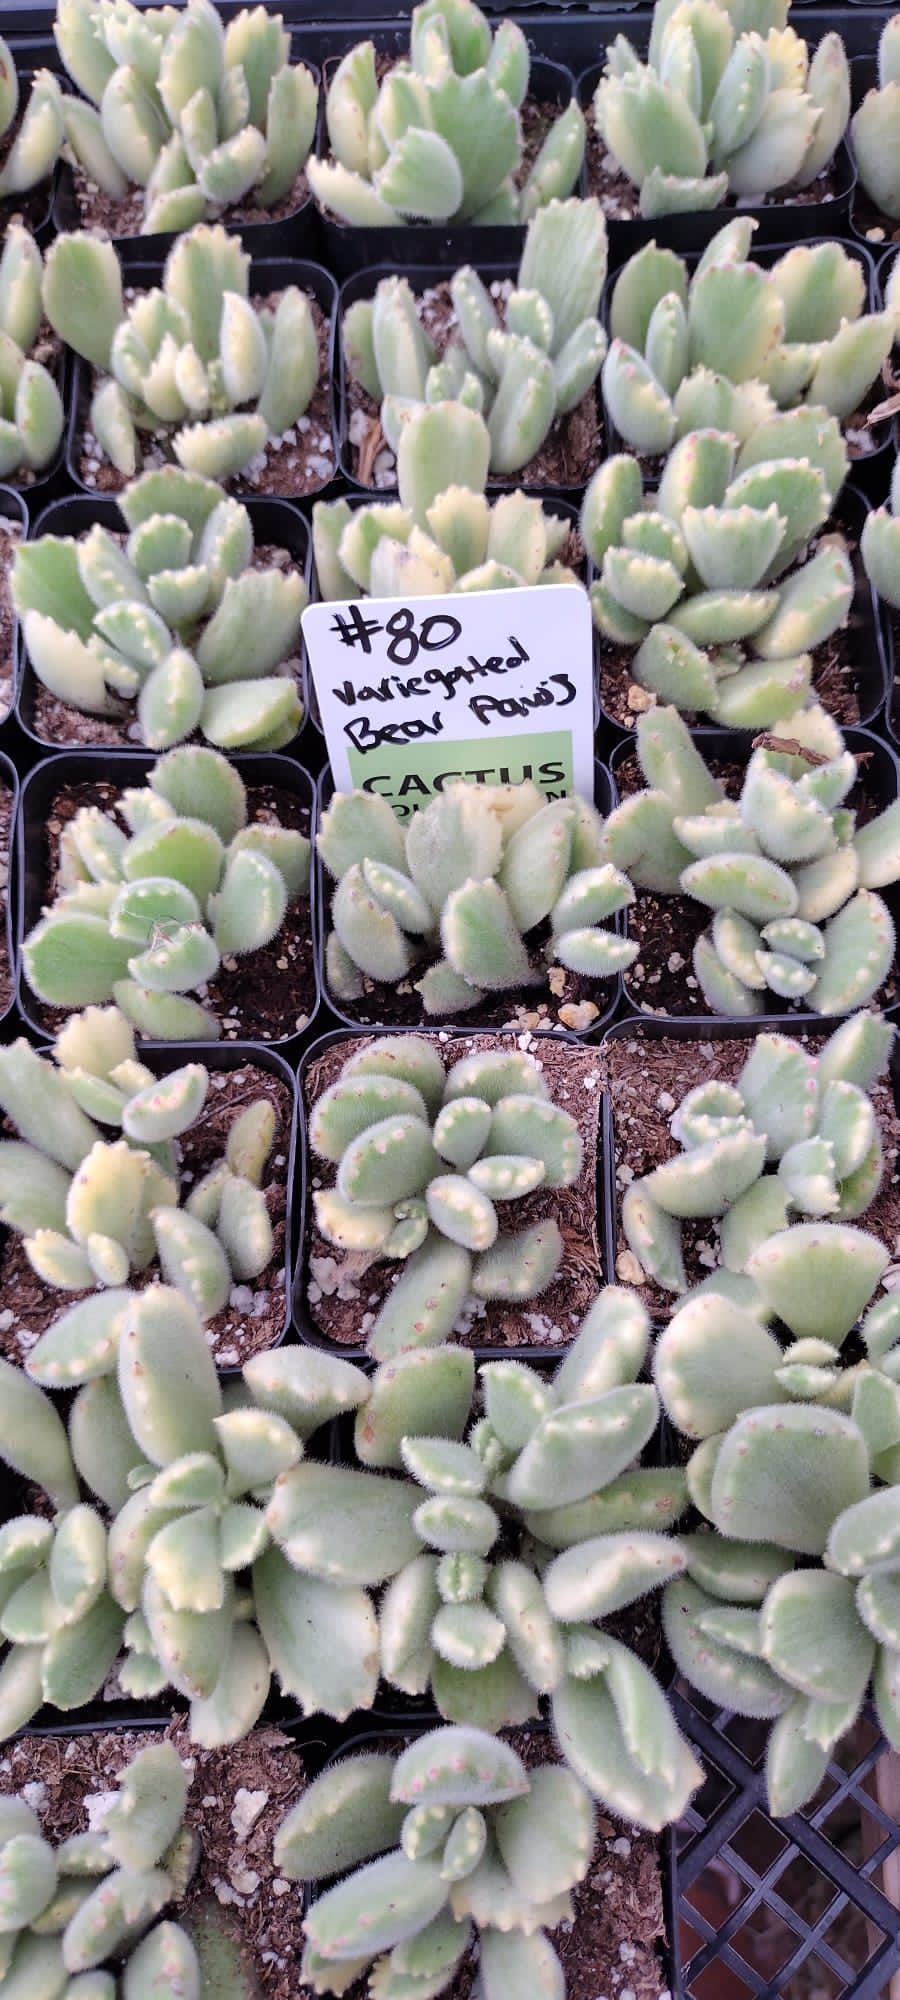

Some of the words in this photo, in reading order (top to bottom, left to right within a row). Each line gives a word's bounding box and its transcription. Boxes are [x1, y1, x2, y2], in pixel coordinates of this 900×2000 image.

[330, 604, 462, 665] #80
[343, 711, 444, 755] Bear
[362, 761, 567, 797] CACTUS
